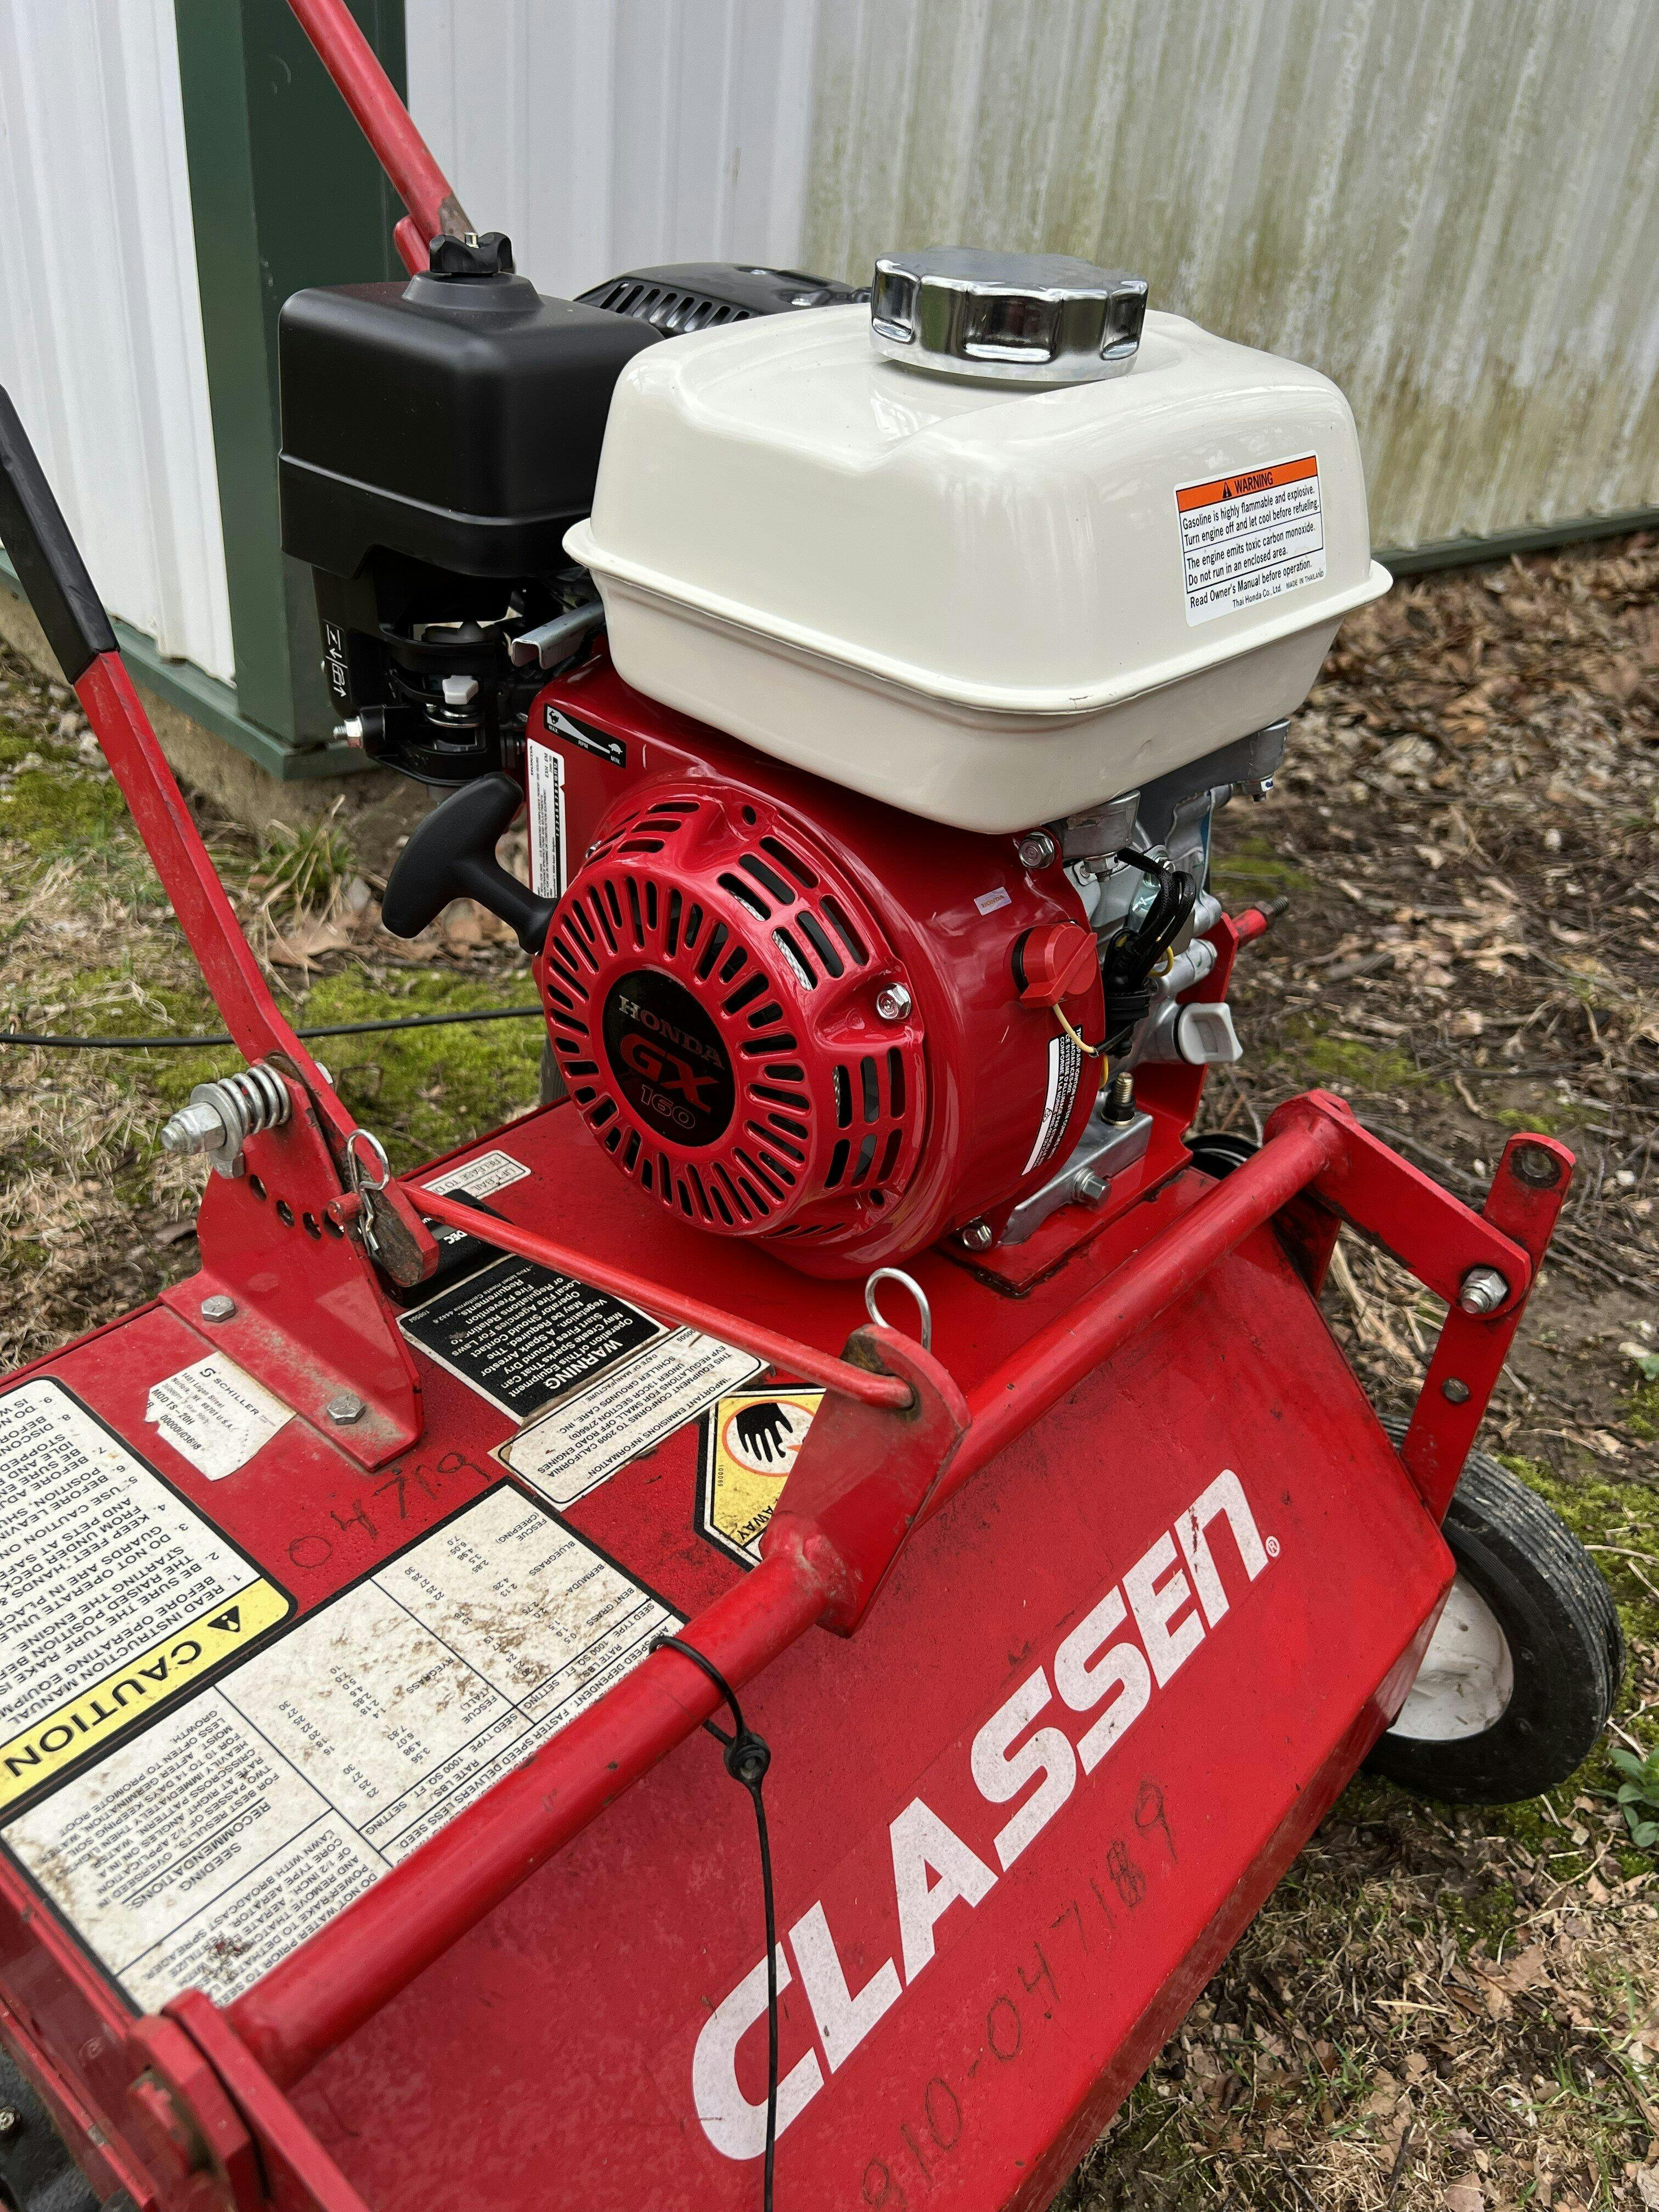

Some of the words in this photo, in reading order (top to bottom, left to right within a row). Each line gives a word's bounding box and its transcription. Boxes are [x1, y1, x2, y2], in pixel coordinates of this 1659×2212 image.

[1234, 471, 1273, 494] WARNING
[1182, 513, 1211, 530] Gasoline
[1212, 510, 1219, 522] is
[1220, 504, 1239, 521] highly
[1240, 495, 1273, 513] flammable
[1274, 490, 1286, 504] and
[1286, 484, 1314, 501] explosive.
[1183, 533, 1200, 546] Turn
[1201, 526, 1223, 541] engine
[1225, 520, 1234, 534] off
[1235, 517, 1248, 532] and
[1248, 515, 1257, 527] let
[1258, 510, 1271, 524] cool
[1272, 506, 1291, 520] before
[1293, 499, 1319, 514] refueling.
[1186, 556, 1200, 569] The
[1201, 550, 1224, 565] engine
[1226, 543, 1244, 557] emits
[1245, 537, 1261, 552] toxic
[1262, 532, 1284, 546] carbon
[1285, 521, 1315, 539] monoxide.
[1188, 573, 1198, 586] Do
[1199, 569, 1211, 583] not
[1212, 566, 1224, 578] run
[1225, 562, 1232, 574] in
[1233, 561, 1242, 572] an
[1243, 549, 1271, 568] enclosed
[1272, 546, 1288, 559] area.
[1189, 591, 1208, 608] Read
[1209, 583, 1236, 601] Owner's
[1237, 574, 1260, 592] Manual
[1261, 569, 1282, 584] before
[1282, 559, 1312, 577] operation.
[1232, 598, 1244, 608] Thai
[1244, 591, 1262, 603] Honda
[1285, 578, 1298, 589] MADE
[1304, 570, 1324, 582] THAILAND
[981, 894, 1005, 909] HONDA
[619, 995, 725, 1070] HONDA
[620, 1033, 720, 1114] GX
[641, 1084, 696, 1129] 160
[557, 1299, 607, 1327] Vegetation.
[578, 1312, 603, 1328] Start
[602, 1311, 623, 1325] May
[518, 1334, 548, 1352] Spark
[545, 1328, 556, 1336] A
[555, 1325, 581, 1341] Fires
[574, 1323, 605, 1343] Create
[589, 1318, 633, 1345] Operation
[521, 1340, 556, 1364] Around
[541, 1341, 575, 1363] Sparks
[558, 1351, 582, 1365] This
[578, 1345, 591, 1353] of
[640, 1353, 658, 1366] DATE
[711, 1345, 726, 1357] EVP
[713, 1352, 732, 1365] THIS
[481, 1350, 519, 1376] Arrestor
[503, 1361, 523, 1374] Dry
[520, 1362, 545, 1376] That
[544, 1339, 622, 1389] WARNING
[632, 1364, 641, 1372] OF
[637, 1356, 676, 1381] SCHILLER
[657, 1363, 685, 1381] UNDER
[659, 1355, 711, 1390] REGULATIONS
[500, 1375, 522, 1389] Can
[508, 1363, 561, 1397] Equipment
[585, 1370, 632, 1402] MANUFACTURE
[631, 1380, 658, 1398] 13CCR
[672, 1363, 715, 1393] EQUIPMENT
[151, 1388, 169, 1403] MOD
[207, 1394, 225, 1408] Street
[213, 1378, 259, 1415] SCHILLER
[599, 1380, 639, 1407] GROUNDS
[642, 1389, 661, 1402] FOR
[573, 1406, 600, 1423] CARE,
[597, 1397, 633, 1421] SECTION
[614, 1401, 644, 1419] SMALL
[628, 1392, 672, 1423] CONFORMS
[556, 1421, 575, 1434] INC.
[600, 1419, 616, 1432] OFF
[616, 1422, 629, 1431] TO
[642, 1407, 686, 1438] EMMISIONS
[574, 1430, 600, 1448] ROAD
[597, 1429, 617, 1444] 2009
[537, 1447, 575, 1473] ENGINES
[547, 1443, 597, 1477] CALIFORNIA
[495, 1511, 539, 1543] (CREEPING)
[516, 1518, 547, 1541] FESCUE
[737, 1505, 774, 1541] AWAY
[111, 1546, 184, 1593] STARTING
[162, 1555, 194, 1576] THE
[205, 1552, 219, 1564] 2.
[528, 1541, 575, 1576] BLUEGRASS
[179, 1562, 202, 1579] BE
[226, 1573, 242, 1584] 1.
[566, 1563, 605, 1593] BERMUDA
[107, 1573, 162, 1610] RAISED
[137, 1577, 179, 1605] SURE
[492, 1577, 509, 1590] 4.28
[499, 1583, 518, 1597] 2.13
[78, 1593, 111, 1614] THE
[155, 1576, 215, 1616] BEFORE
[184, 1584, 224, 1613] READ
[613, 1587, 635, 1605] BENT
[105, 1602, 138, 1626] THE
[585, 1604, 614, 1626] GRASS
[633, 1602, 654, 1621] SEED
[13, 1612, 77, 1651] ENGINE.
[31, 1609, 105, 1657] POSITION
[64, 1625, 105, 1654] TURF
[612, 1620, 635, 1638] TYPE
[64, 1615, 154, 1674] OPERATING
[80, 1612, 182, 1680] INSTRUCTION
[623, 1640, 654, 1664] SPEED
[14, 1651, 60, 1683] RAKE
[406, 1656, 454, 1694] RYEGRASS
[523, 1679, 560, 1709] SETTING
[574, 1663, 625, 1707] DEPENDENT.
[3, 1640, 202, 1778] CAUTION
[8, 1678, 78, 1723] MANUAL
[460, 1687, 489, 1710] (TALL)
[461, 1695, 497, 1724] FESCUE
[532, 1708, 569, 1739] FASTER
[501, 1737, 534, 1765] SPEED
[442, 1756, 464, 1774] 1000
[452, 1759, 479, 1781] RATE
[422, 1770, 446, 1789] SQ.
[454, 1763, 502, 1803] DELIVERS
[408, 1784, 428, 1801] FT.
[427, 1802, 455, 1825] LESS
[693, 1469, 1269, 2160] CLASSEN
[396, 1823, 428, 1848] SEED.
[179, 1842, 241, 1891] SEEDING
